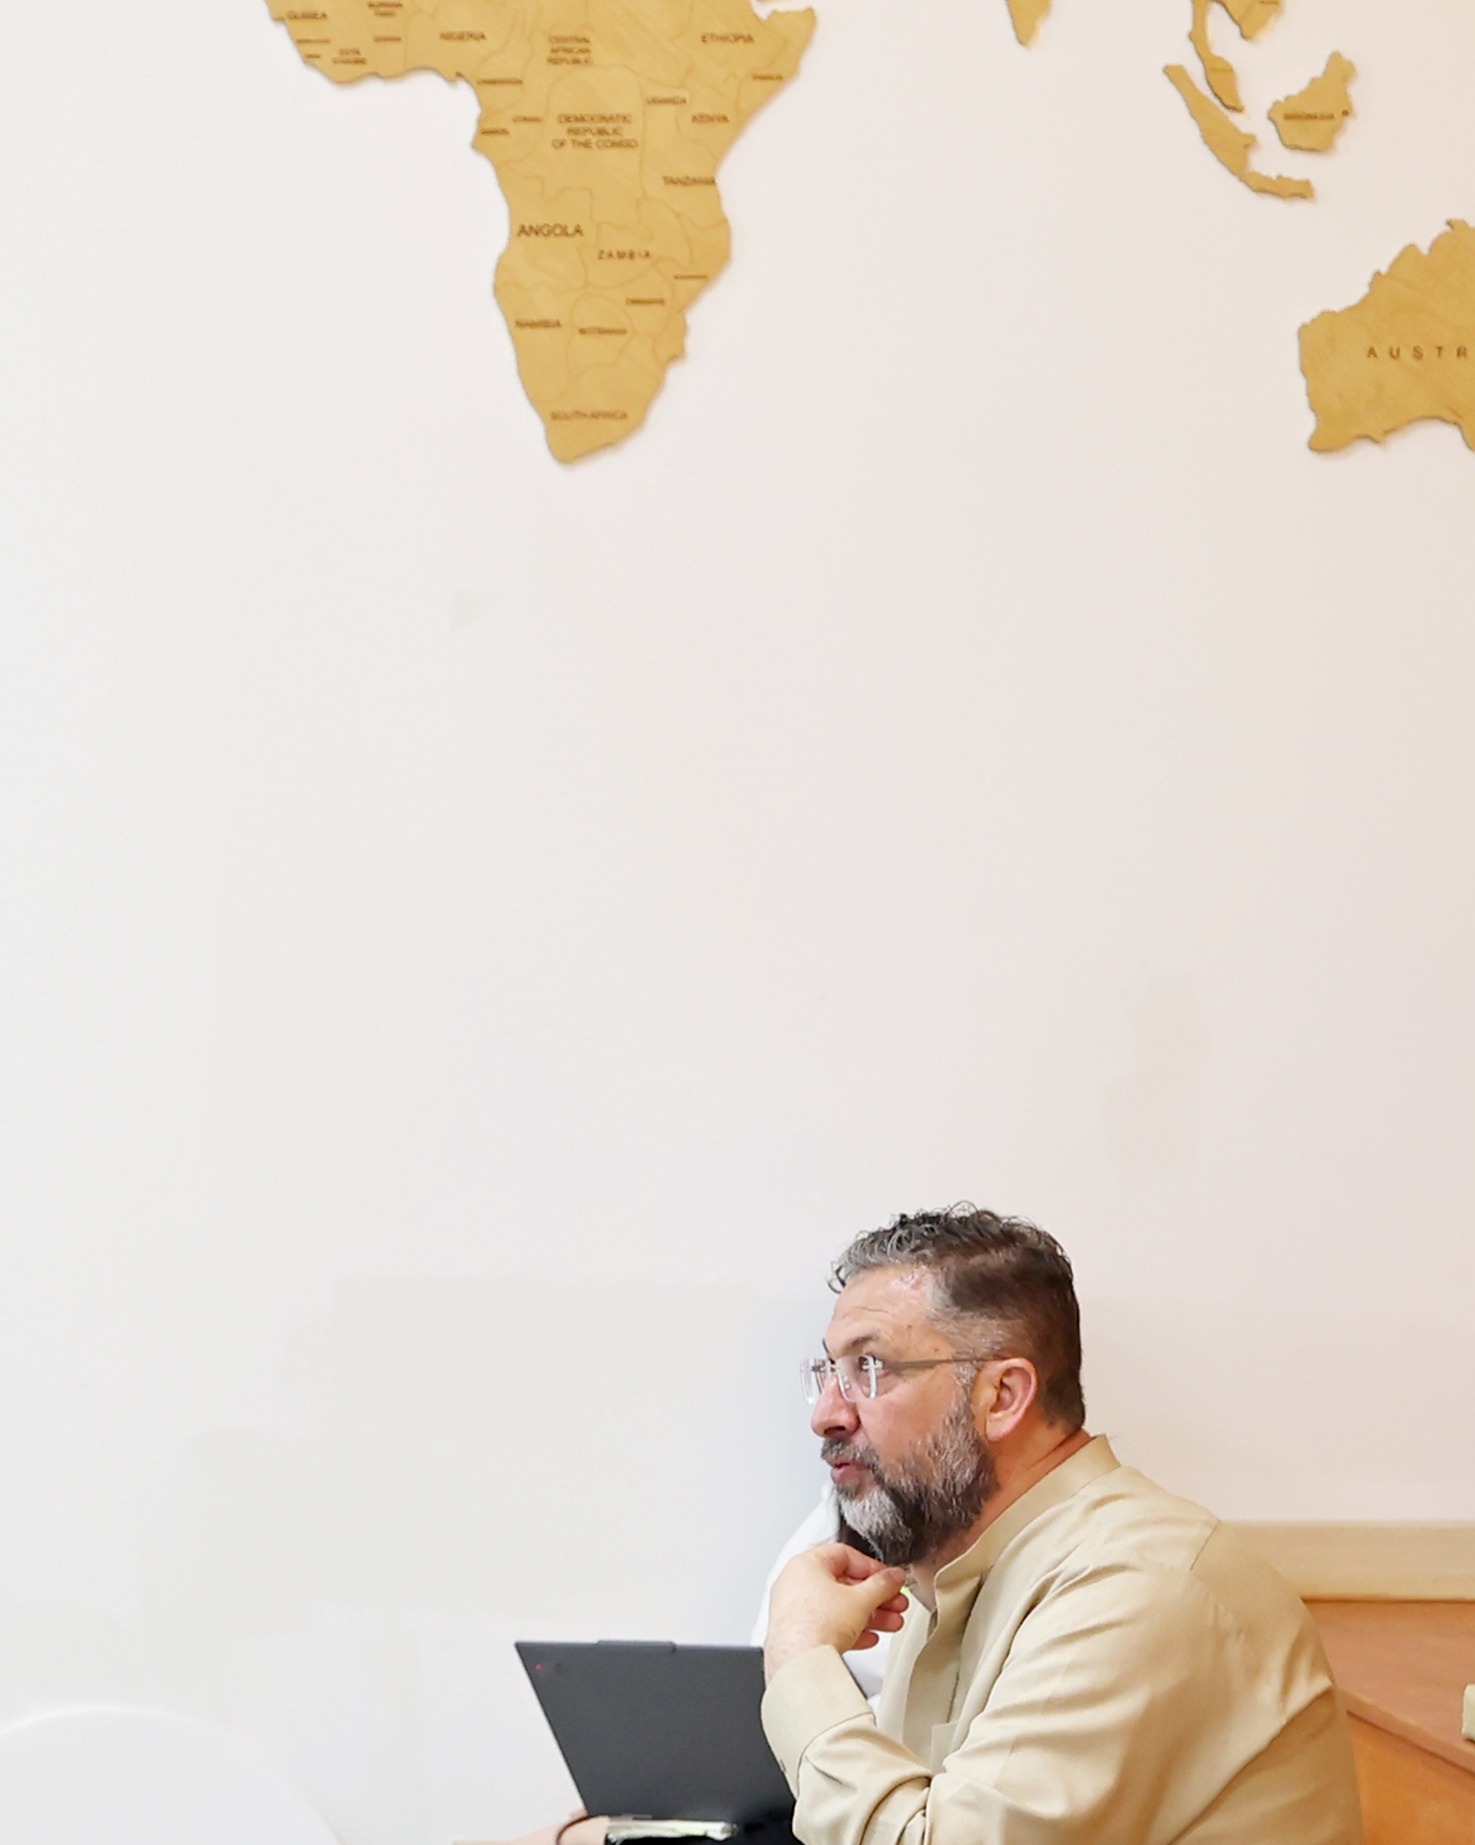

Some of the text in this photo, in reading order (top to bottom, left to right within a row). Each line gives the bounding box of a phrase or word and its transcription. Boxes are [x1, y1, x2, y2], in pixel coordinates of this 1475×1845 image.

[571, 139, 593, 149] THE
[517, 223, 585, 238] ANGOLA
[597, 249, 652, 260] ZAMBIA
